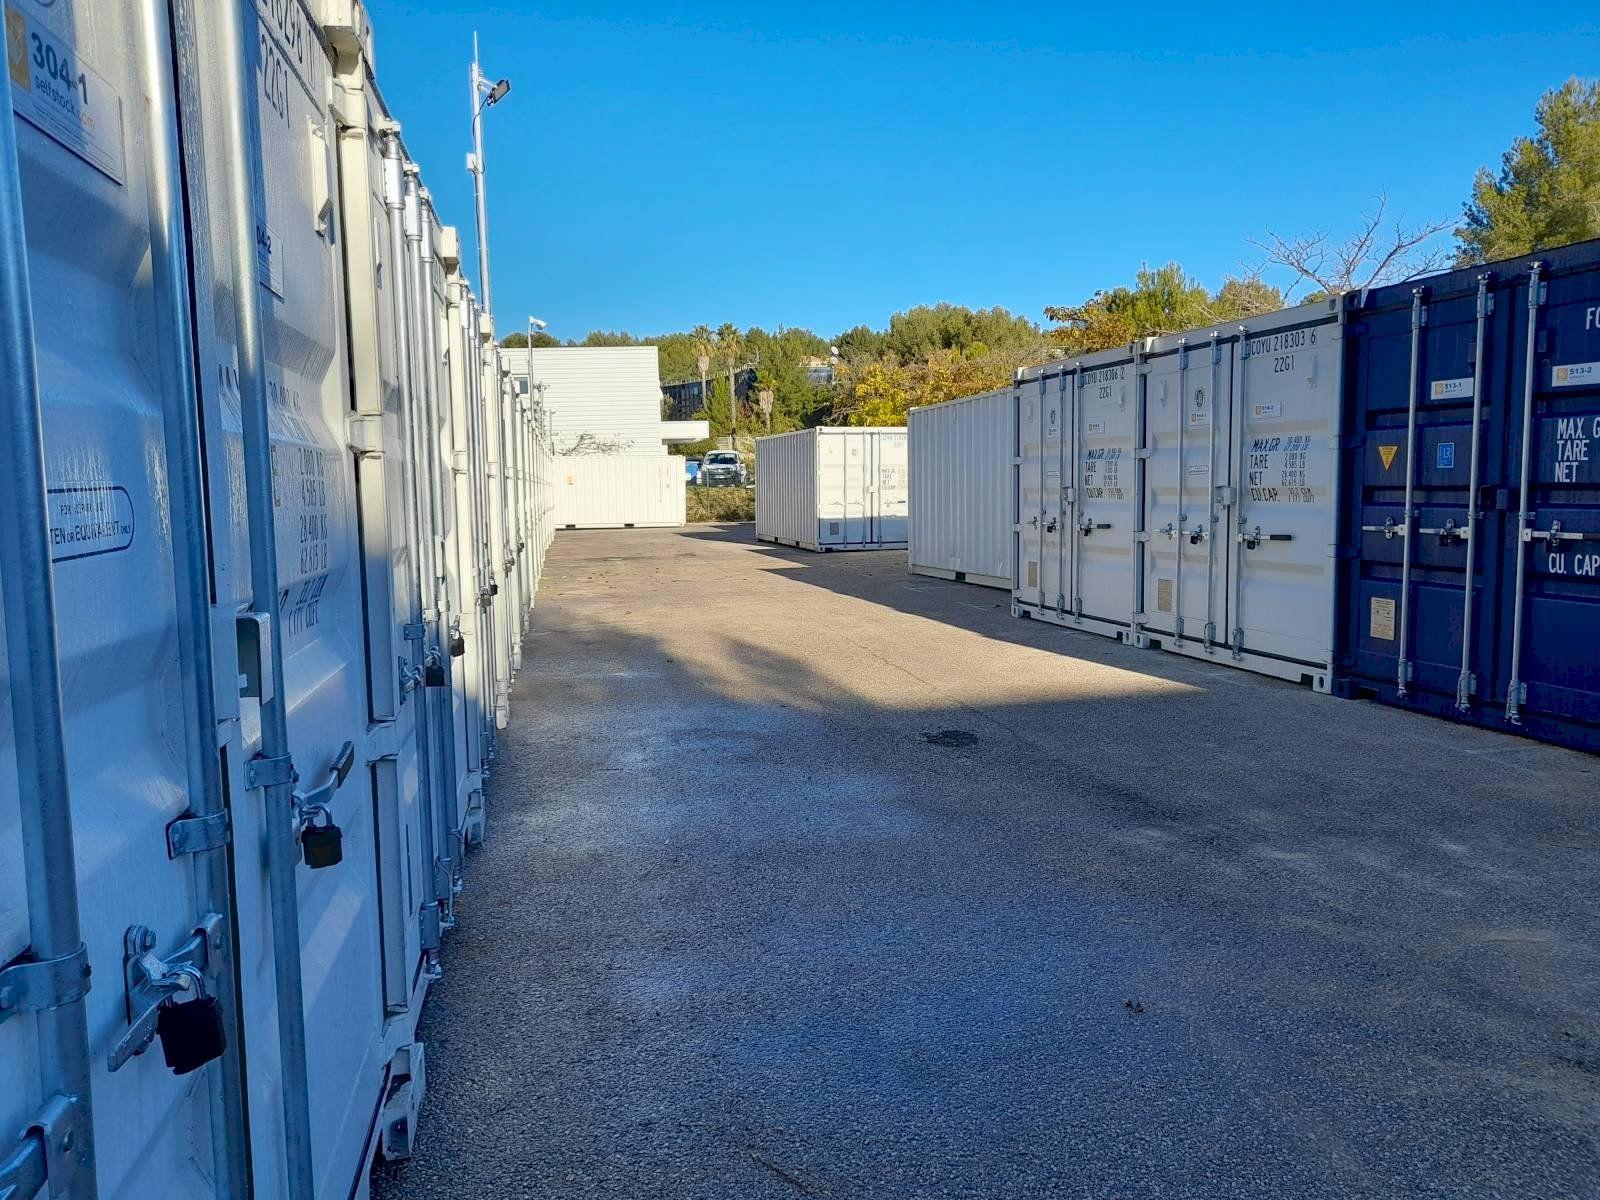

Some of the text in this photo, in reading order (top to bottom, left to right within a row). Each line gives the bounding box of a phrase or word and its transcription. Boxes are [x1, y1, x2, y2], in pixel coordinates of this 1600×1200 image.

[1252, 328, 1317, 356] COYU 218303 6
[1274, 355, 1294, 373] 22G1
[1557, 417, 1586, 439] MAX.
[1557, 440, 1590, 461] TARE
[1250, 454, 1269, 469] TARE
[1249, 471, 1262, 486] NET
[1555, 462, 1579, 483] NET
[1549, 552, 1567, 575] CU.
